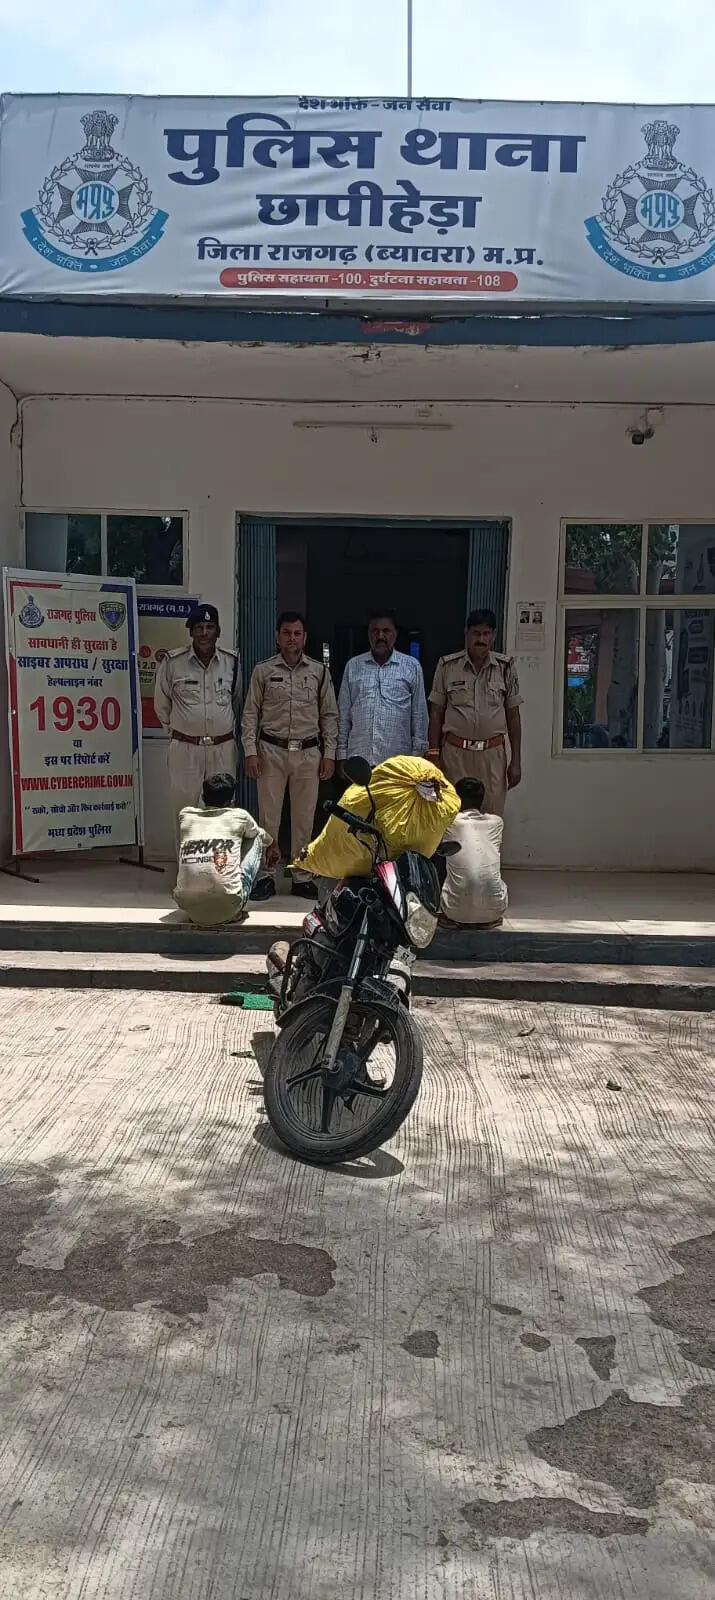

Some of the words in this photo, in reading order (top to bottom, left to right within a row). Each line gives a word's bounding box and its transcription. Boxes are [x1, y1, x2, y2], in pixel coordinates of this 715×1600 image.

[163, 112, 382, 186] पुलिस
[400, 128, 587, 173] थाना
[256, 179, 483, 235] छापीहेड़ा
[197, 236, 263, 261] जिला
[267, 244, 358, 265] राजगढ़
[364, 244, 476, 264] (ब्यावरा)
[483, 247, 544, 266] म.प्र.
[237, 271, 275, 287] पुलिस
[278, 274, 329, 285] सहायता
[370, 271, 413, 287] दुर्घटना
[417, 276, 467, 286] सहायता
[47, 609, 72, 623] राजगढ़
[74, 608, 96, 624] पुलिस
[27, 637, 68, 650] सावधानी
[71, 637, 80, 650] ही
[83, 639, 108, 653] सुरक्षा
[17, 656, 51, 669] साइबर
[54, 657, 88, 669] अपराध
[92, 657, 97, 671] /
[101, 659, 128, 673] सुरक्षा
[86, 675, 103, 687] नंबर
[29, 695, 121, 732] 1930
[72, 739, 82, 748] या
[44, 756, 58, 767] इस
[60, 755, 72, 765] पर
[73, 753, 97, 765] रिपोर्ट
[97, 751, 111, 764] करें
[21, 774, 134, 791] WWW.CYBERCRIME.GOV.IN
[88, 824, 112, 838] पुलिस
